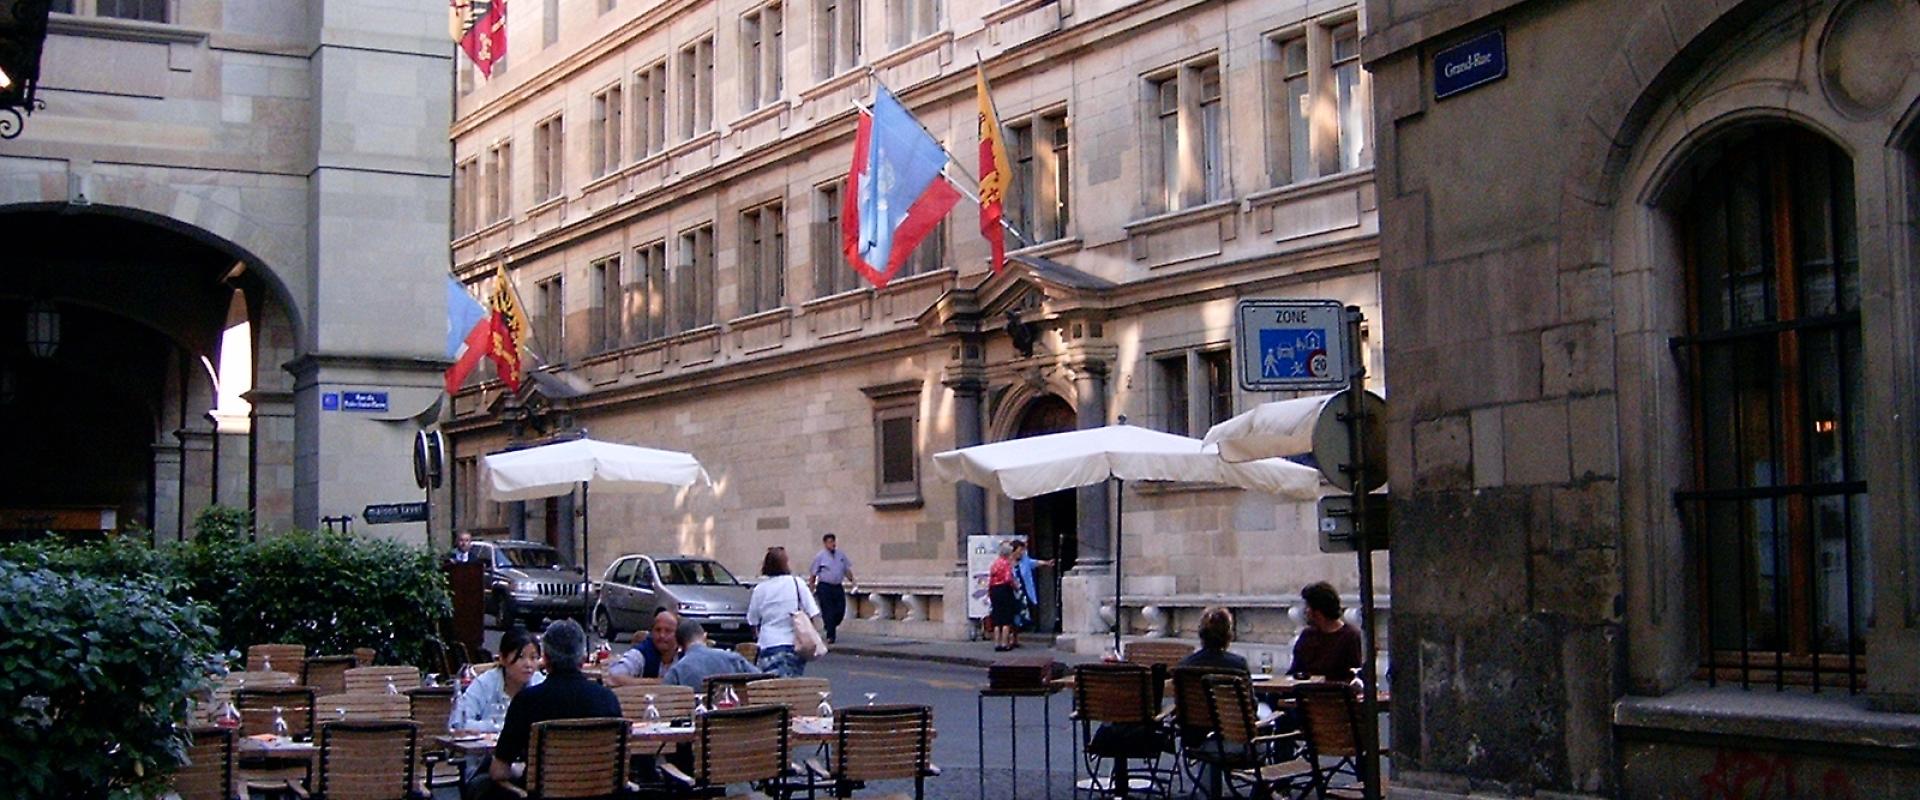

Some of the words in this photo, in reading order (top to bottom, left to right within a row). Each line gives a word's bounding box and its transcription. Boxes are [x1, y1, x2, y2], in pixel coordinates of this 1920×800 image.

[1444, 52, 1492, 78] Grand-Rue
[1275, 310, 1308, 324] ZONE
[1314, 358, 1327, 371] 20
[369, 507, 399, 516] maison
